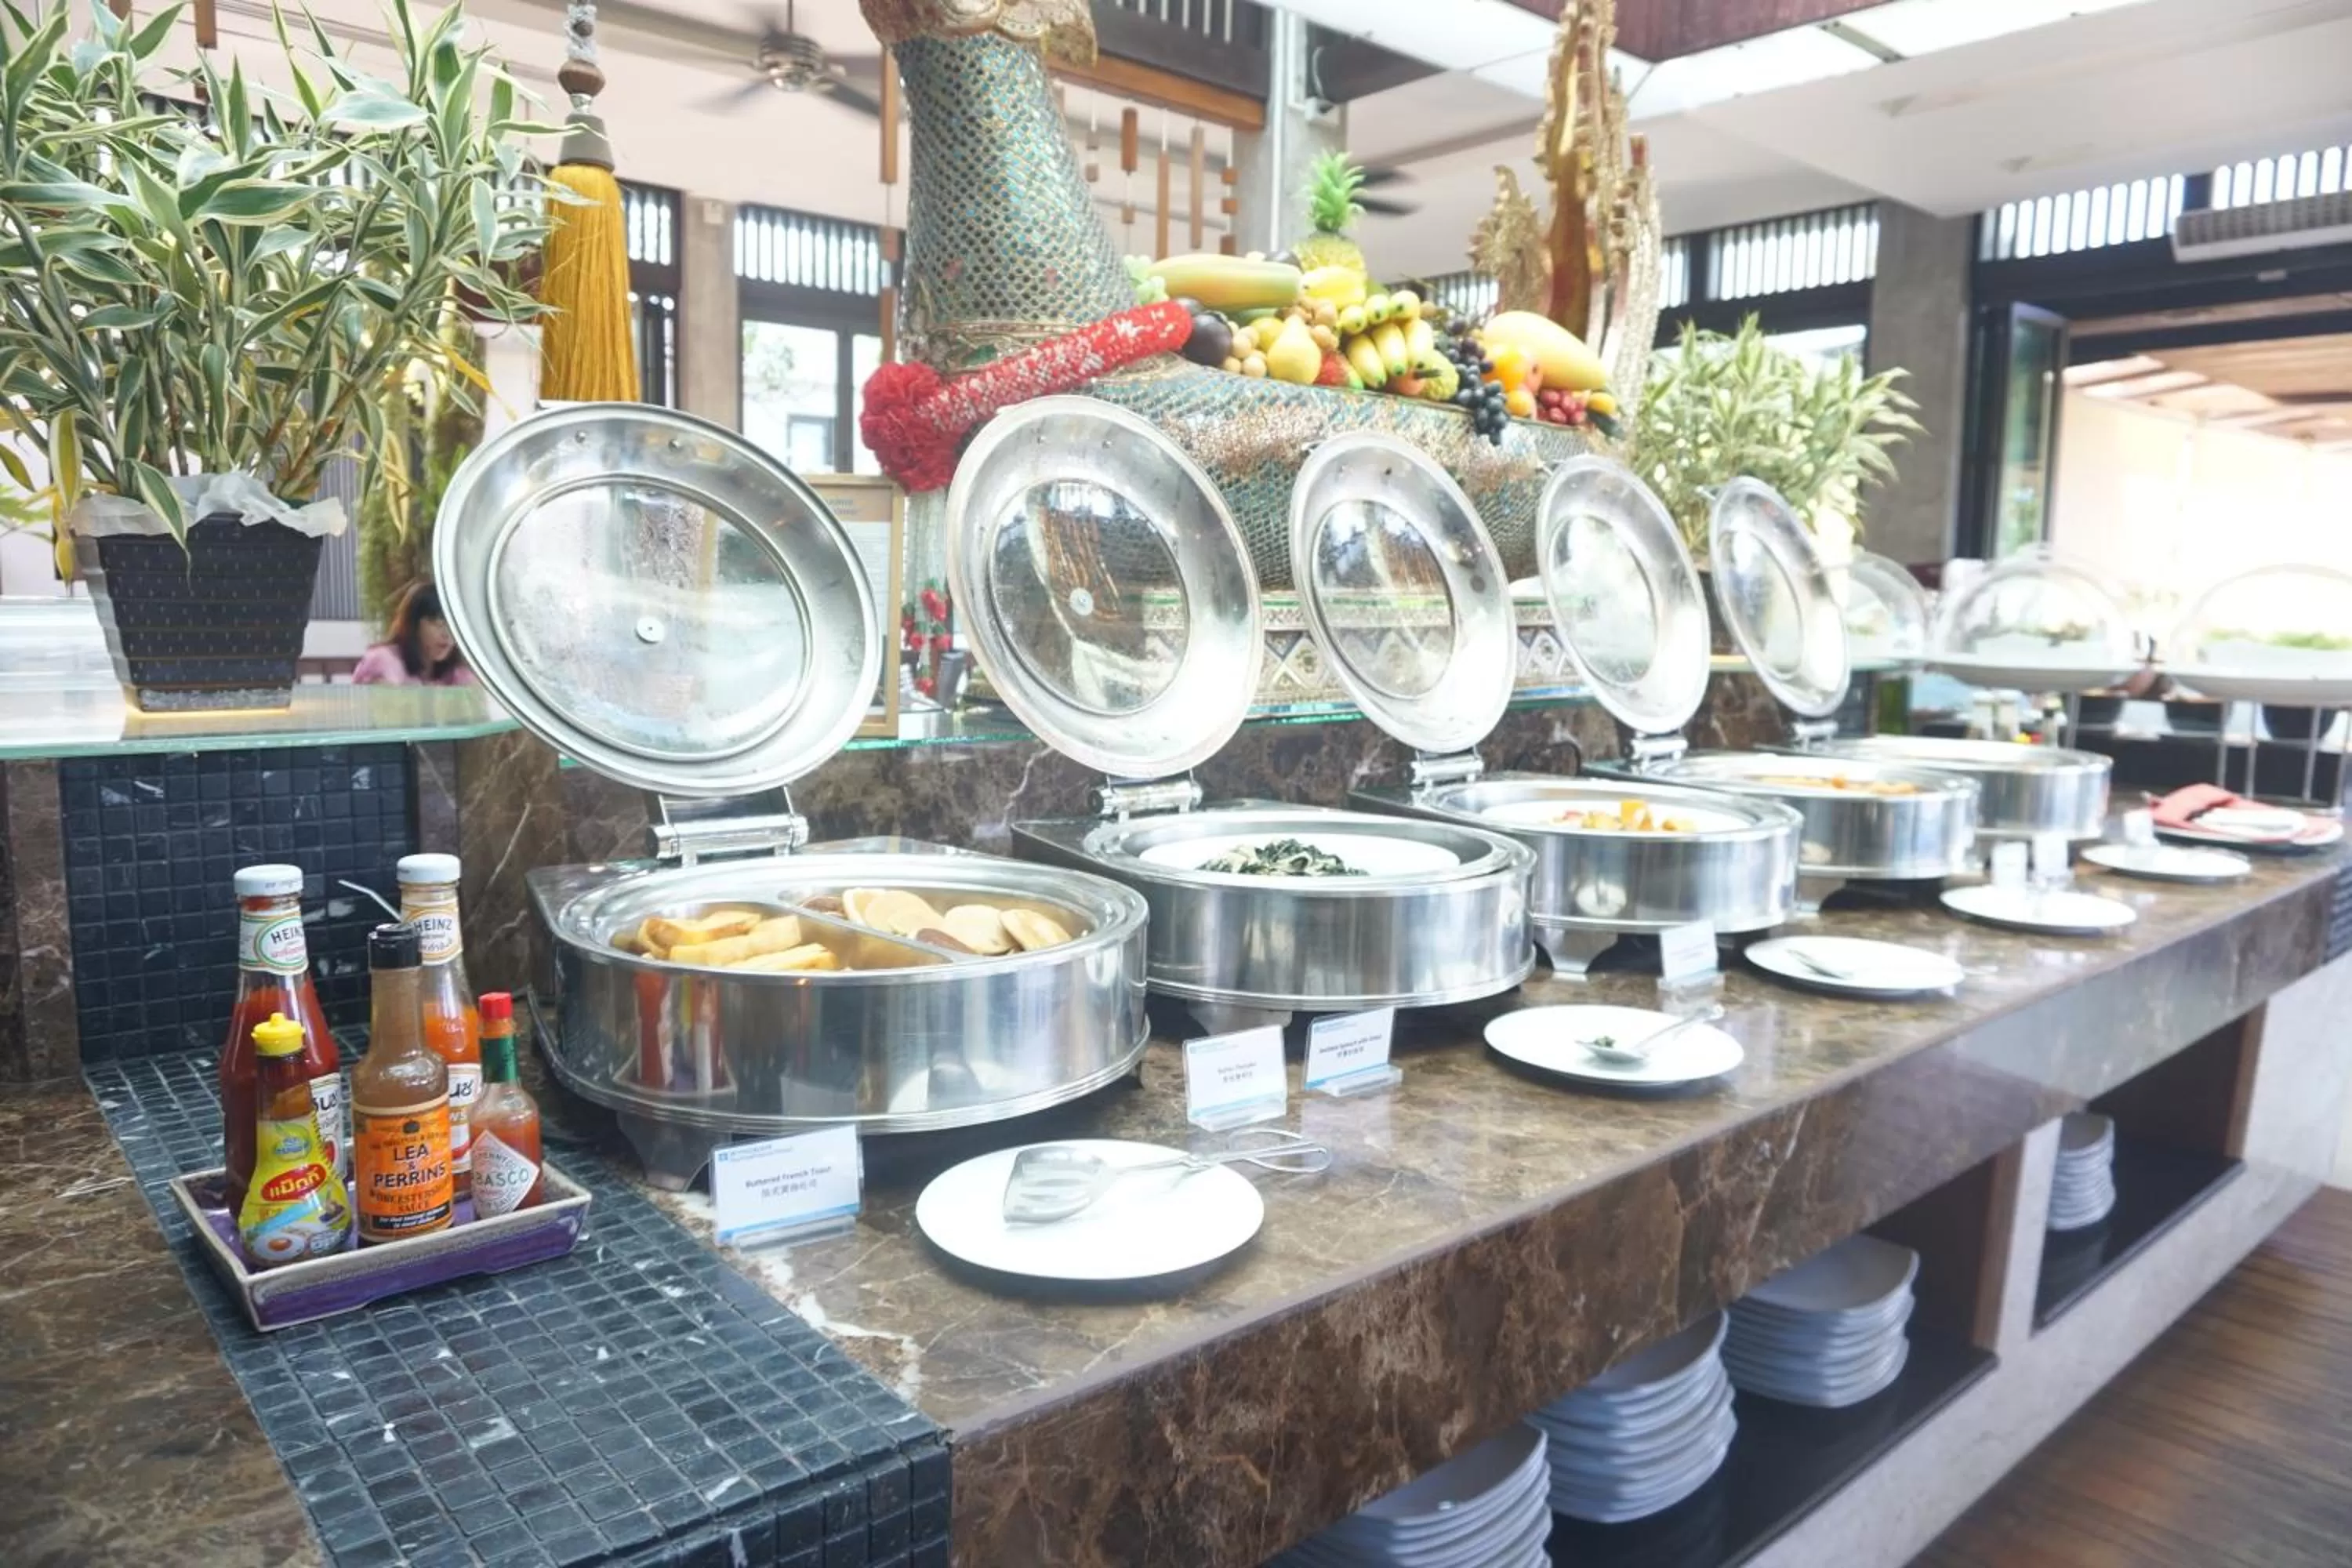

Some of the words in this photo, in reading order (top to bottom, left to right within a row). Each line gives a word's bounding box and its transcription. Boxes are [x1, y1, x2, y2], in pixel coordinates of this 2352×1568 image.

[414, 918, 452, 932] HEINZ
[394, 1144, 429, 1161] LEA
[374, 1163, 446, 1189] PERRINS
[475, 1167, 530, 1189] BASCO
